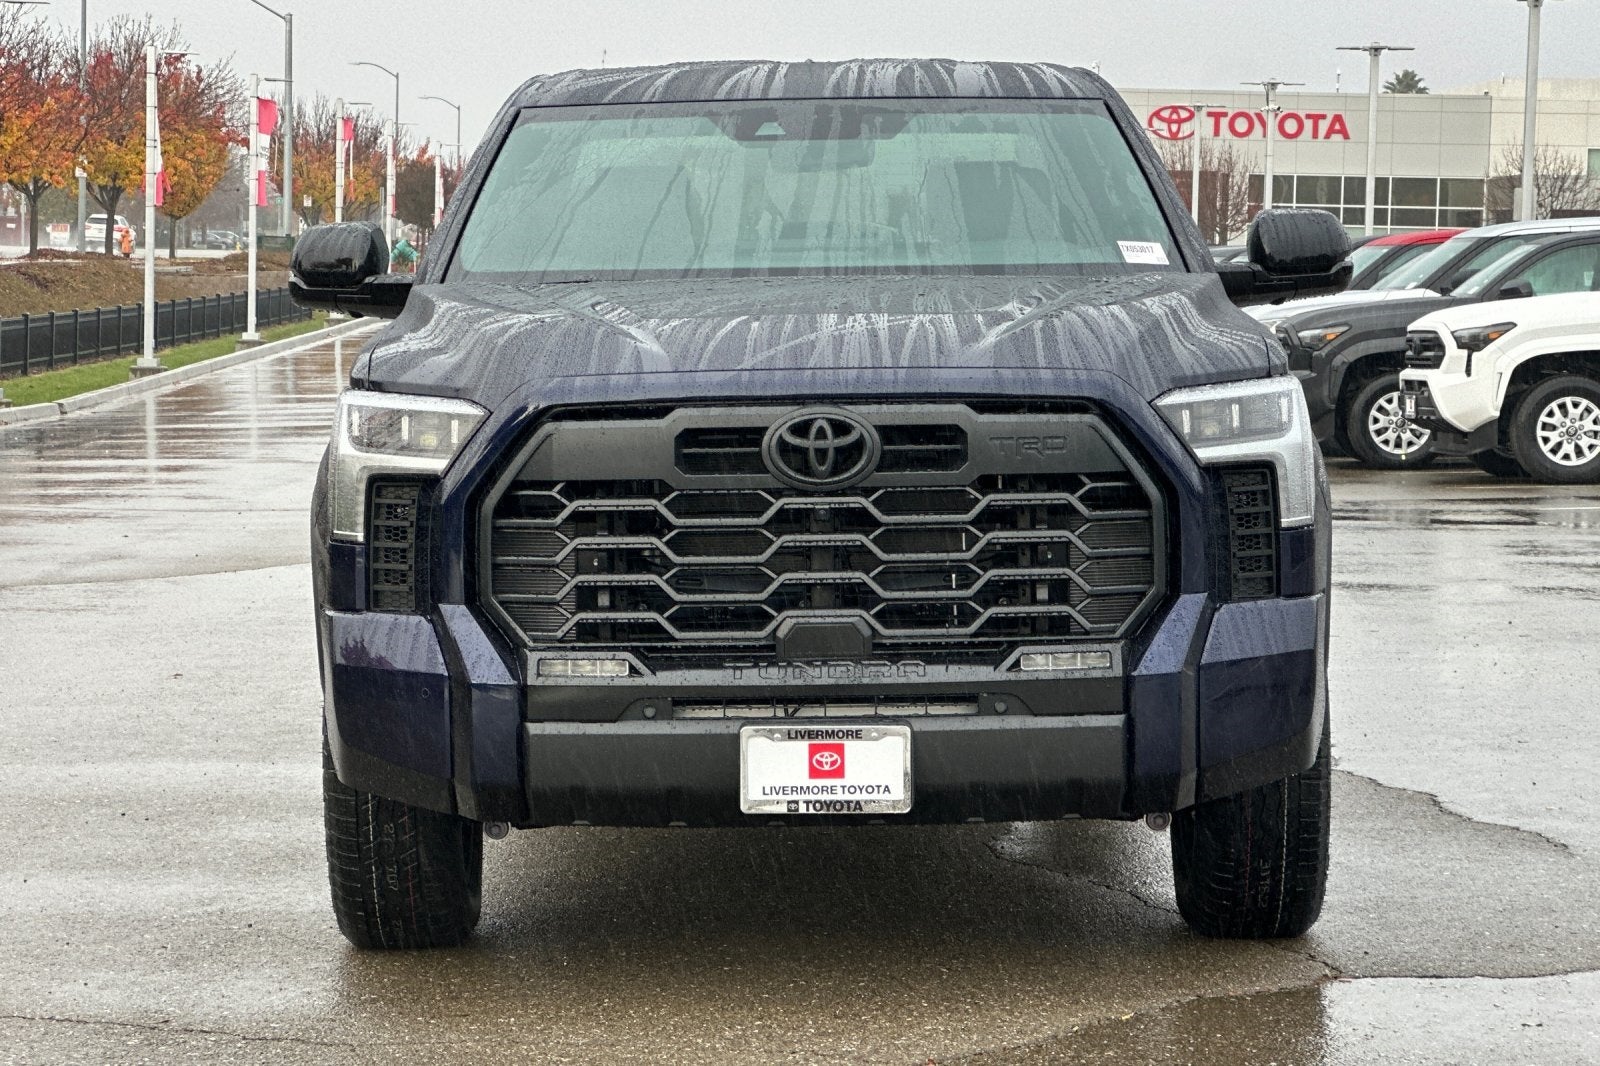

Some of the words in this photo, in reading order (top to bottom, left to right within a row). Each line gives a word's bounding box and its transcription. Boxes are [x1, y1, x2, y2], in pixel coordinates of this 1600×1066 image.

[1206, 110, 1350, 140] TOYOTA
[989, 436, 1067, 458] TRD
[722, 660, 926, 680] TUNDRA
[787, 729, 863, 740] LIVERMORE
[762, 785, 838, 796] LIVERMORE
[840, 784, 892, 795] TOYOTA
[803, 800, 863, 812] TOYOTA
